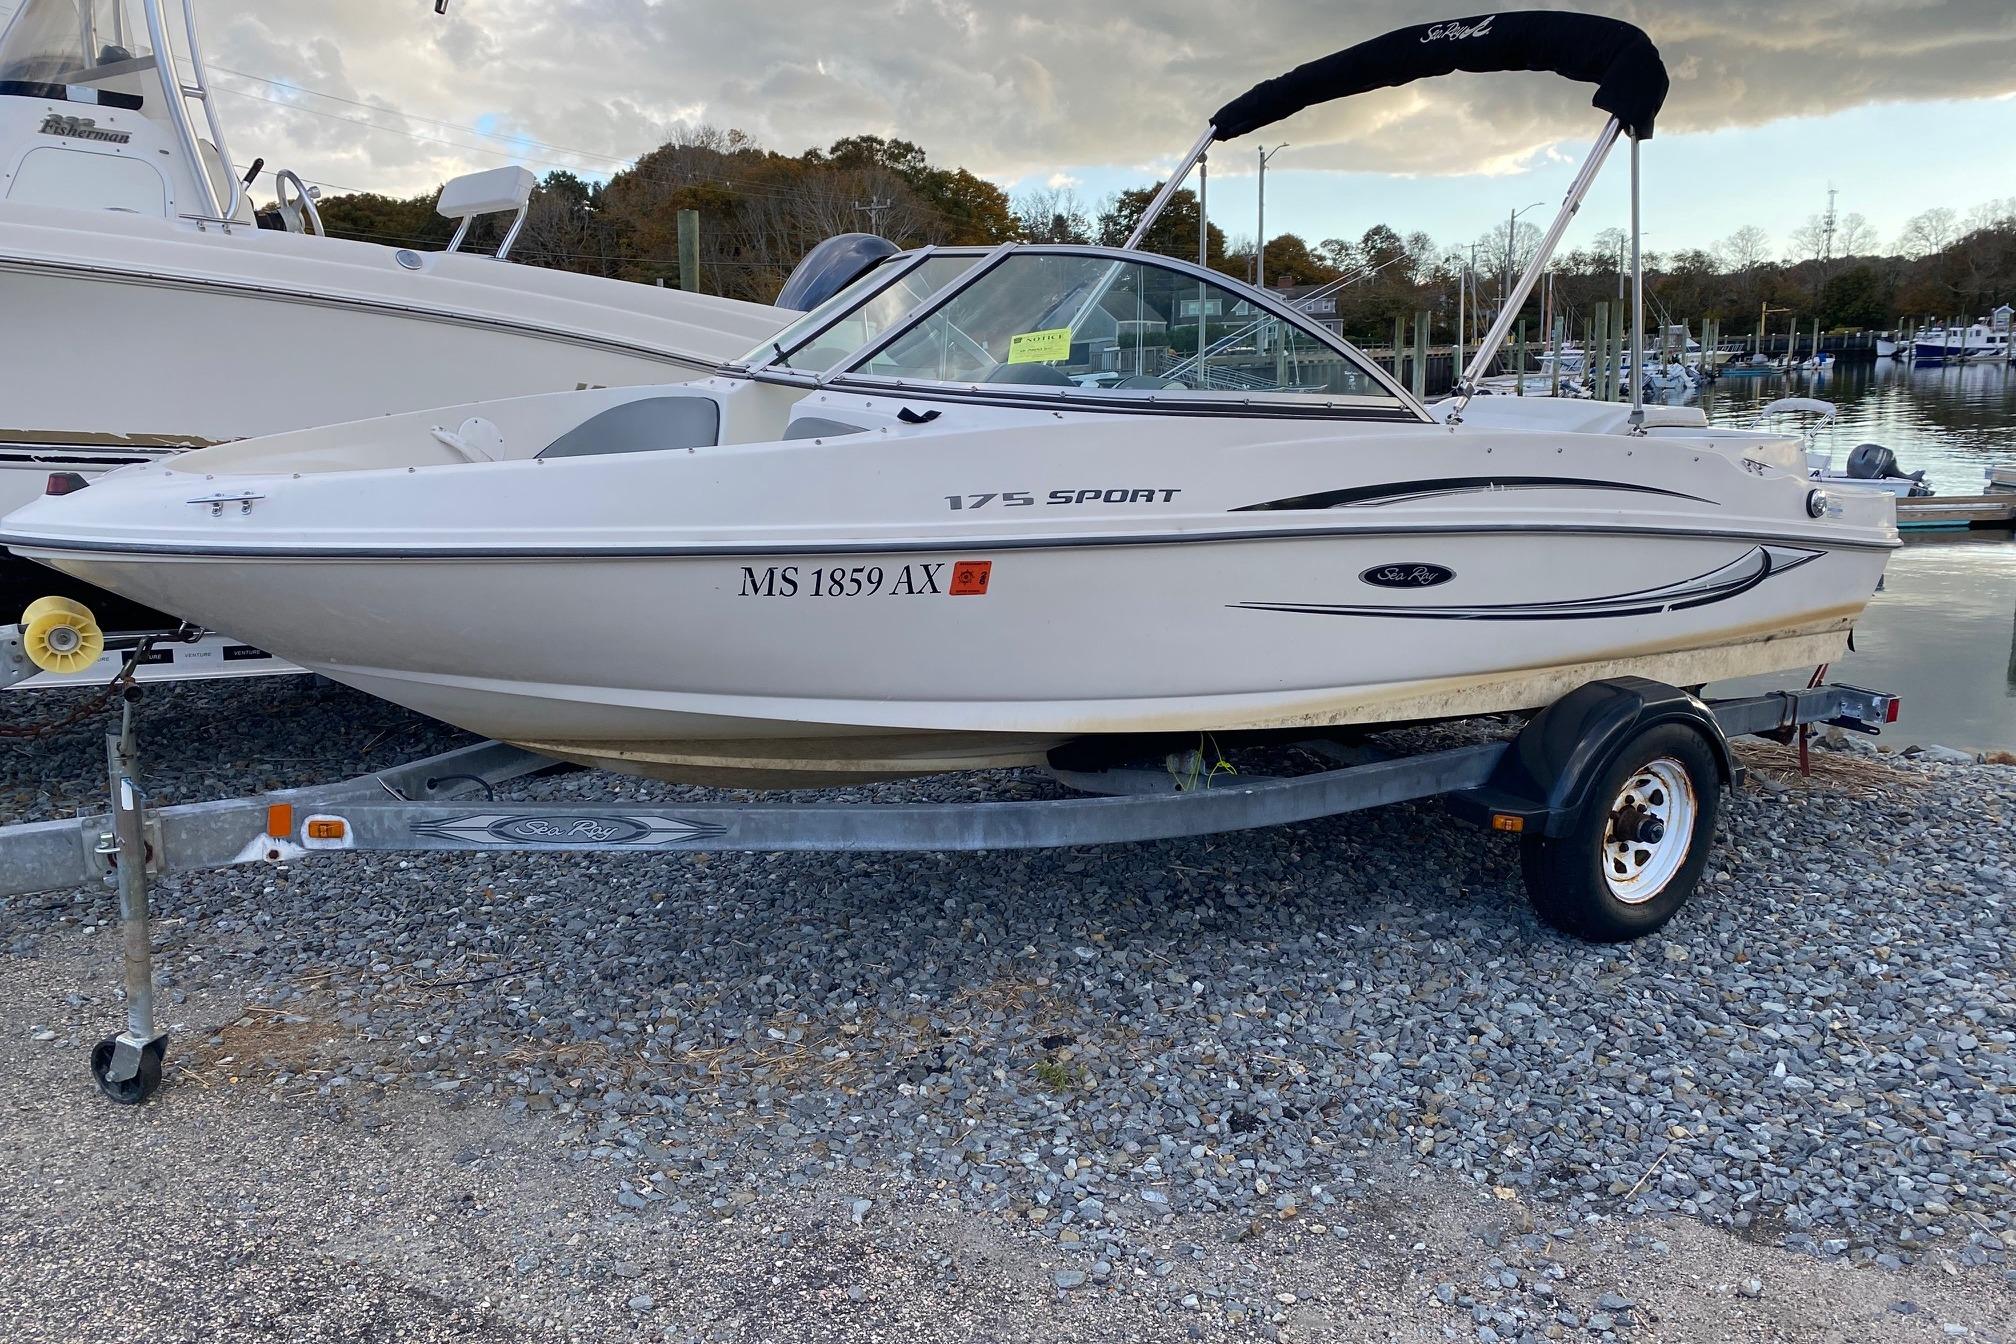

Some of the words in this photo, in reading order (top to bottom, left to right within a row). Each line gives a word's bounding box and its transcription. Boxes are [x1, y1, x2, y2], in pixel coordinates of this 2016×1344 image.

[38, 118, 130, 144] Fisherman
[944, 491, 1035, 510] 175
[1047, 489, 1182, 505] SPORT
[738, 566, 799, 597] MS
[810, 565, 884, 597] 1859
[889, 563, 945, 595] AX
[1377, 567, 1407, 581] Sea
[1407, 566, 1439, 585] Ray
[514, 820, 566, 836] Sea
[566, 819, 619, 841] Ray
